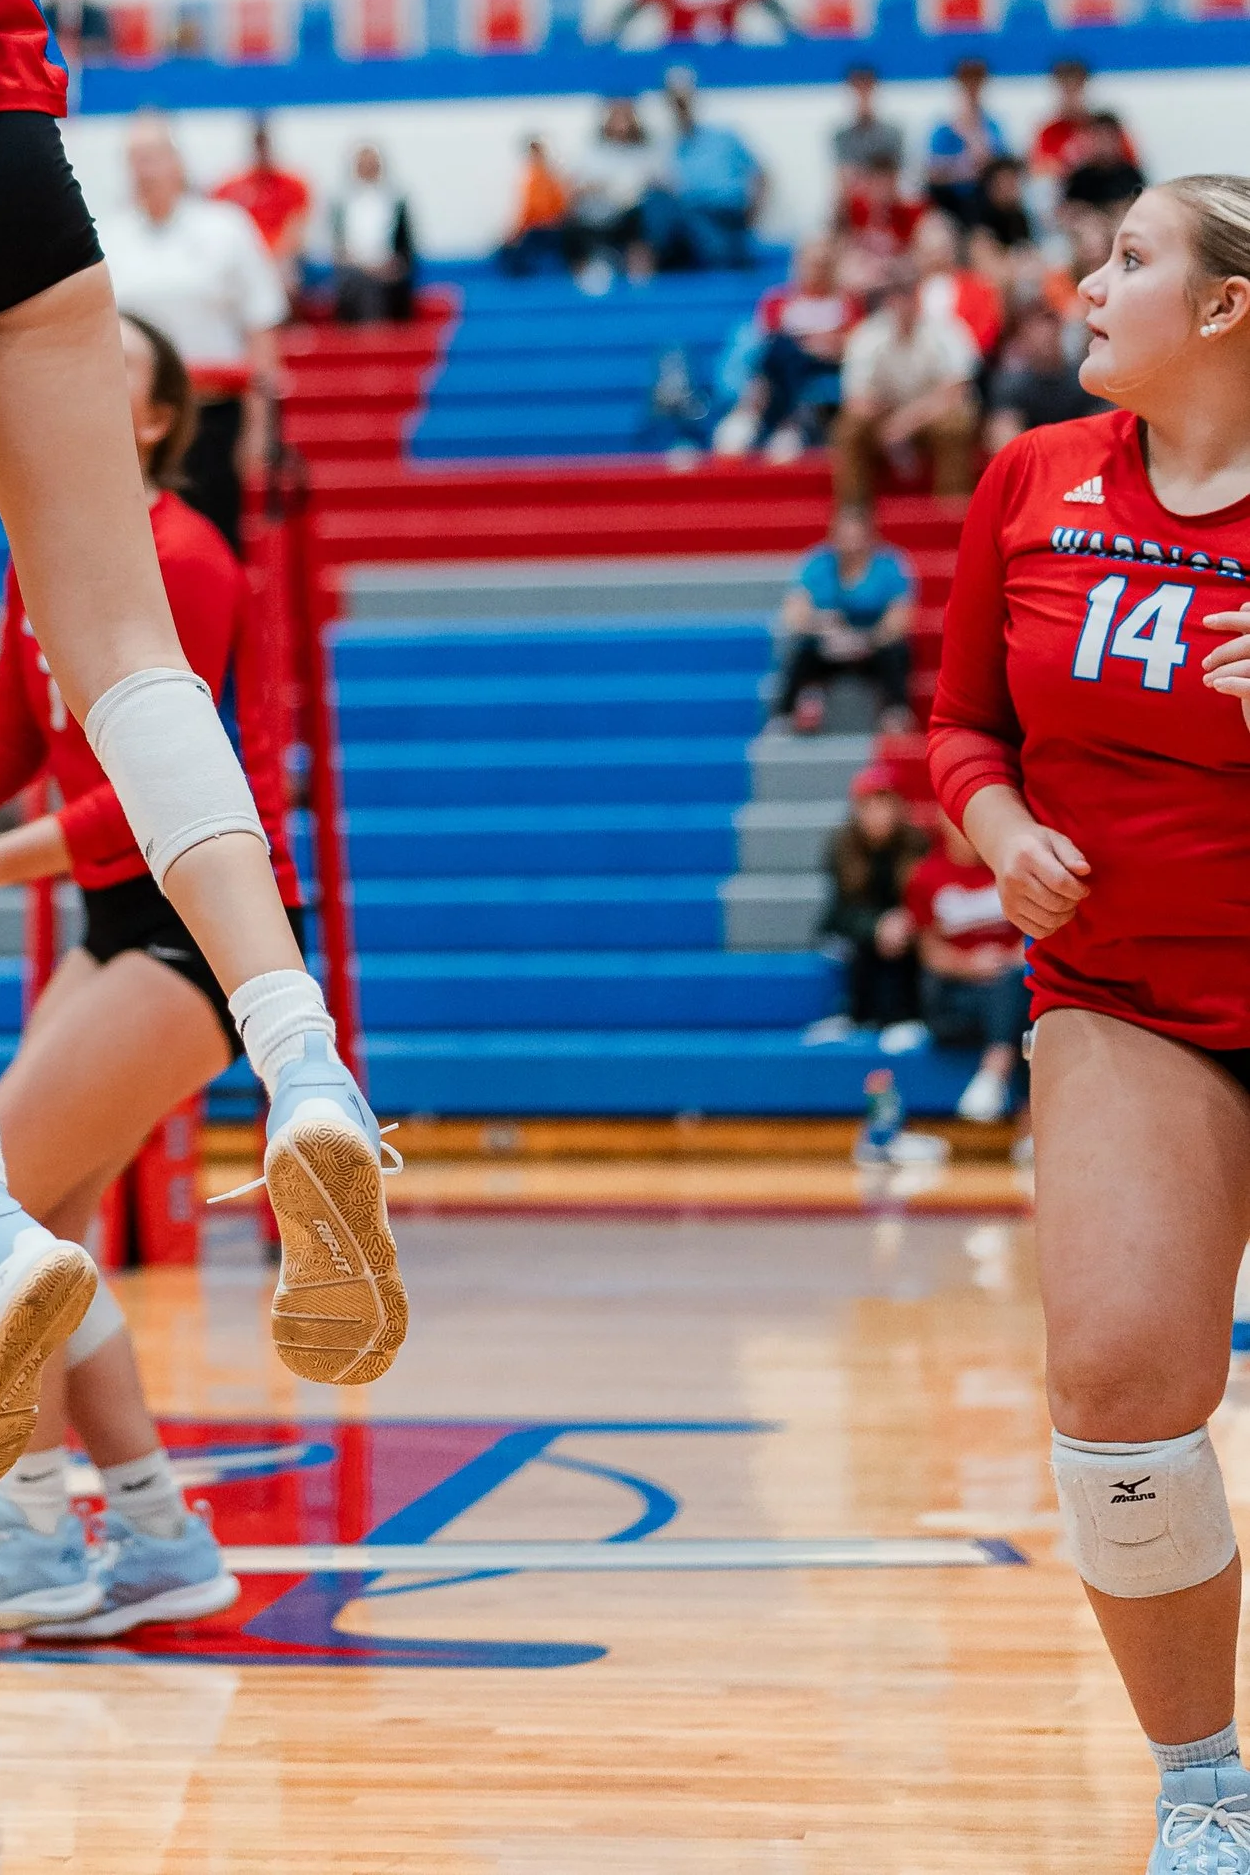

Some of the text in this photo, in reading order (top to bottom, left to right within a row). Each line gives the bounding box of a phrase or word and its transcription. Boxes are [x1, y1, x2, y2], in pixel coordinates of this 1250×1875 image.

[1063, 491, 1106, 505] adidas
[1071, 573, 1196, 693] 14
[311, 1218, 354, 1275] RIP-IT
